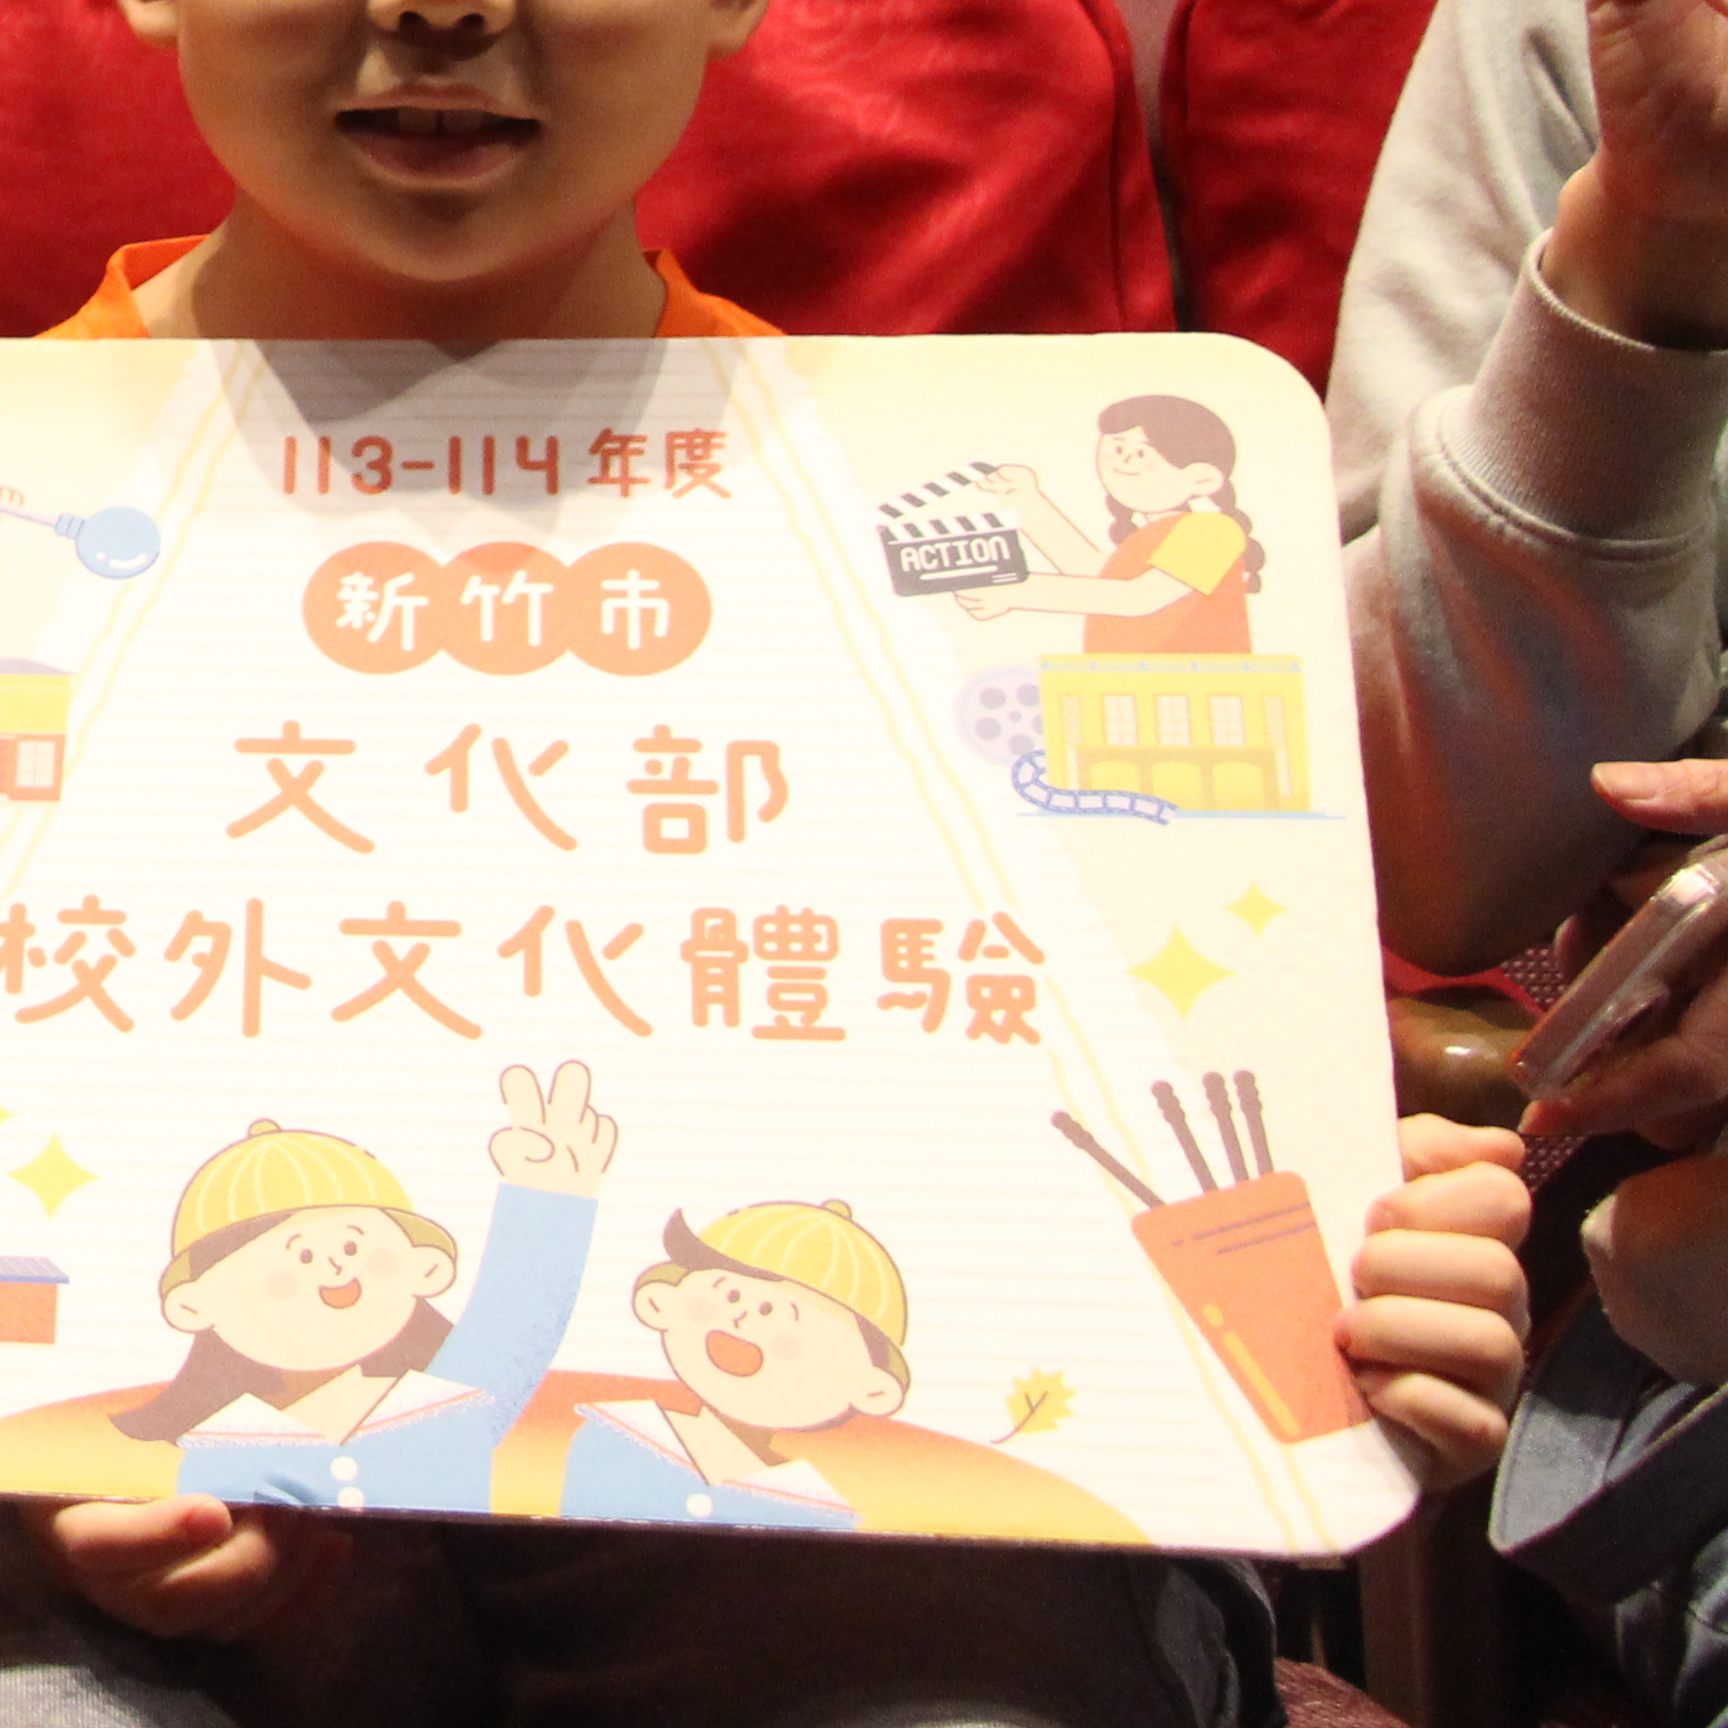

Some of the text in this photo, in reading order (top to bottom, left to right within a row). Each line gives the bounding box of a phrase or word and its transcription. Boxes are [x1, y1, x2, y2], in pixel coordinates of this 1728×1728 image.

[899, 535, 1011, 572] ACTION
[336, 569, 670, 651] 新竹市
[225, 720, 789, 855] 文化部
